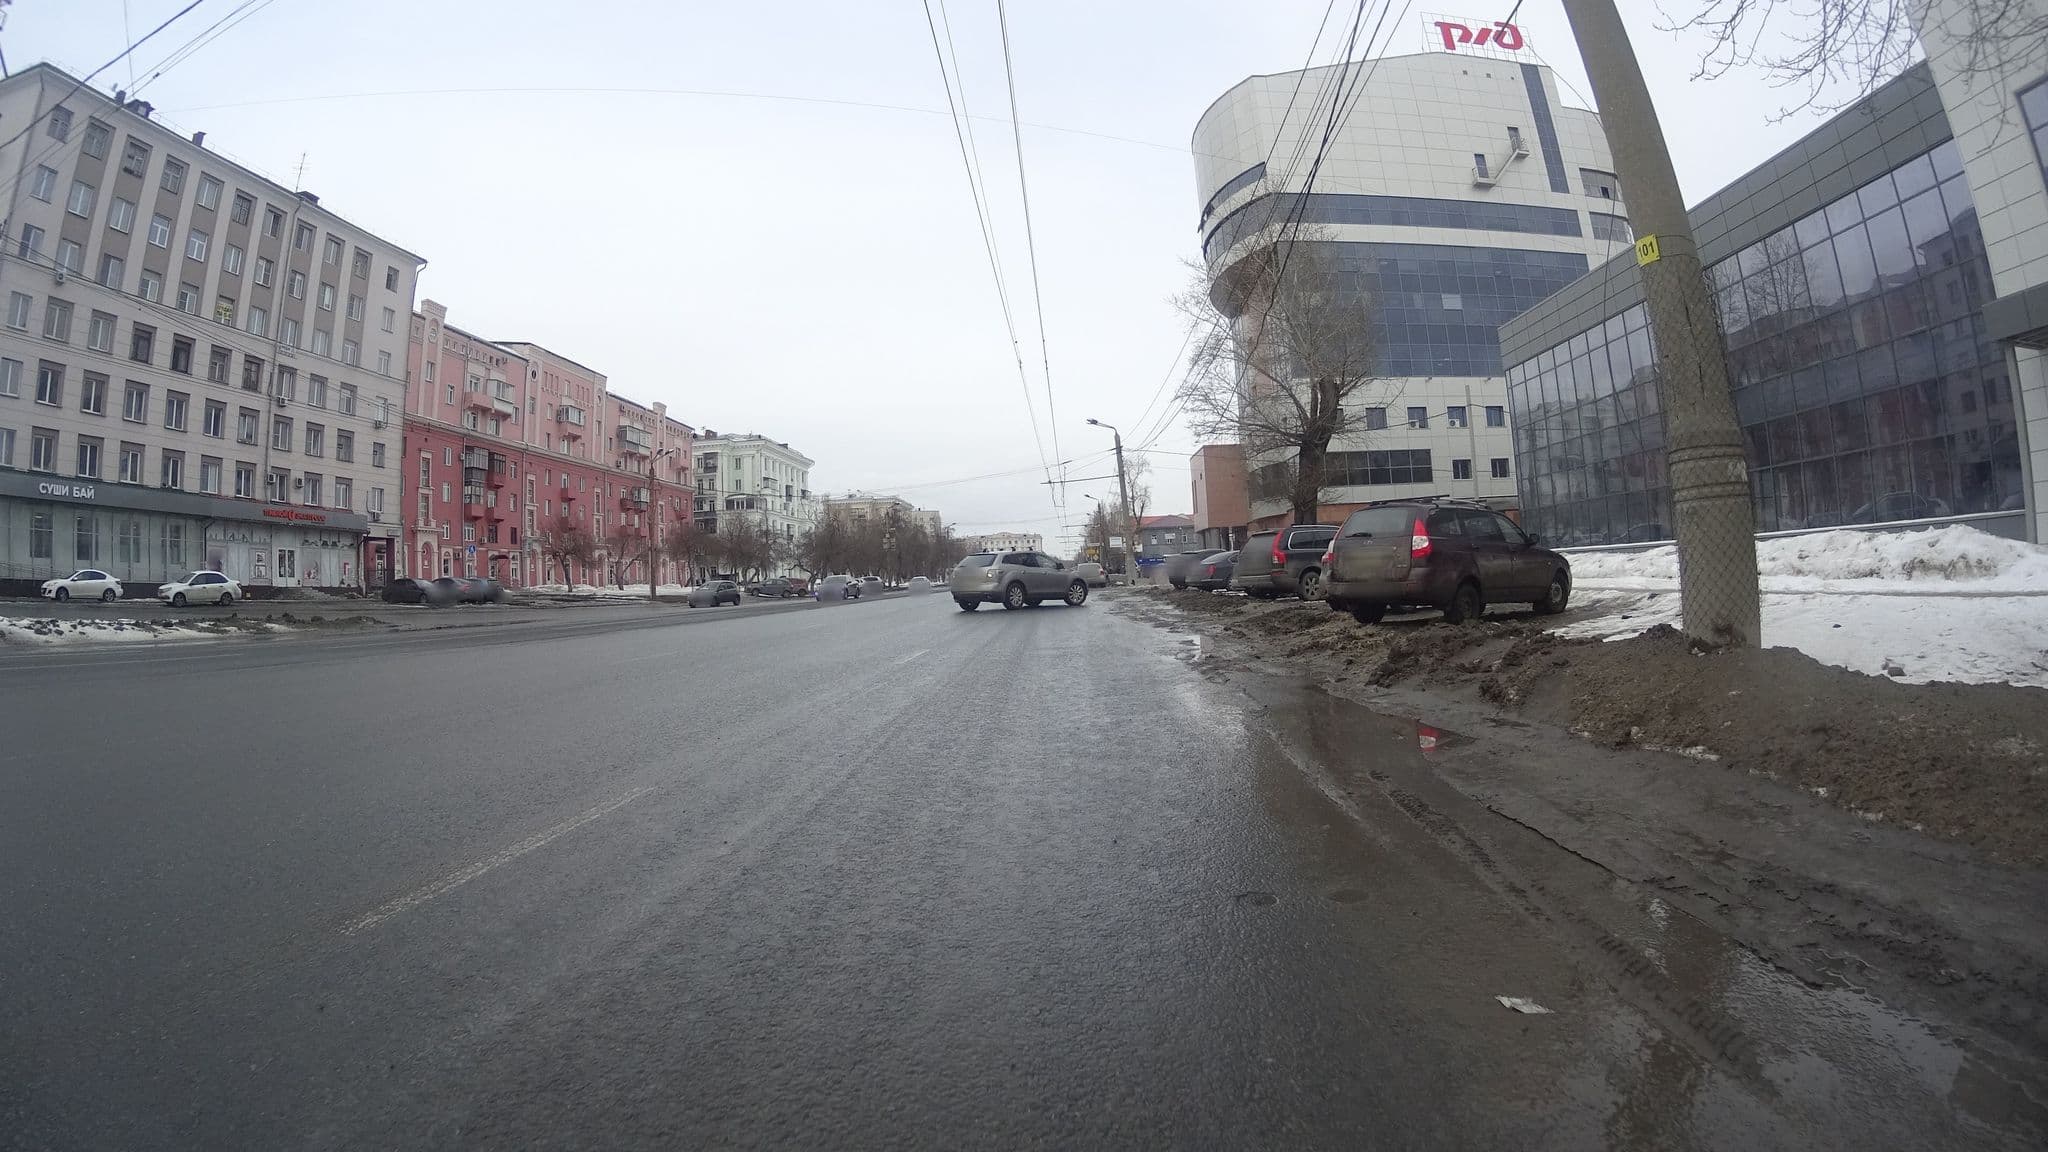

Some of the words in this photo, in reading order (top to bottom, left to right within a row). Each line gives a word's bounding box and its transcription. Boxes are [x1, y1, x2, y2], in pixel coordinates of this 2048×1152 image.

[1638, 241, 1655, 258] 101
[39, 482, 69, 496] СУШИ
[73, 485, 95, 499] БАЙ
